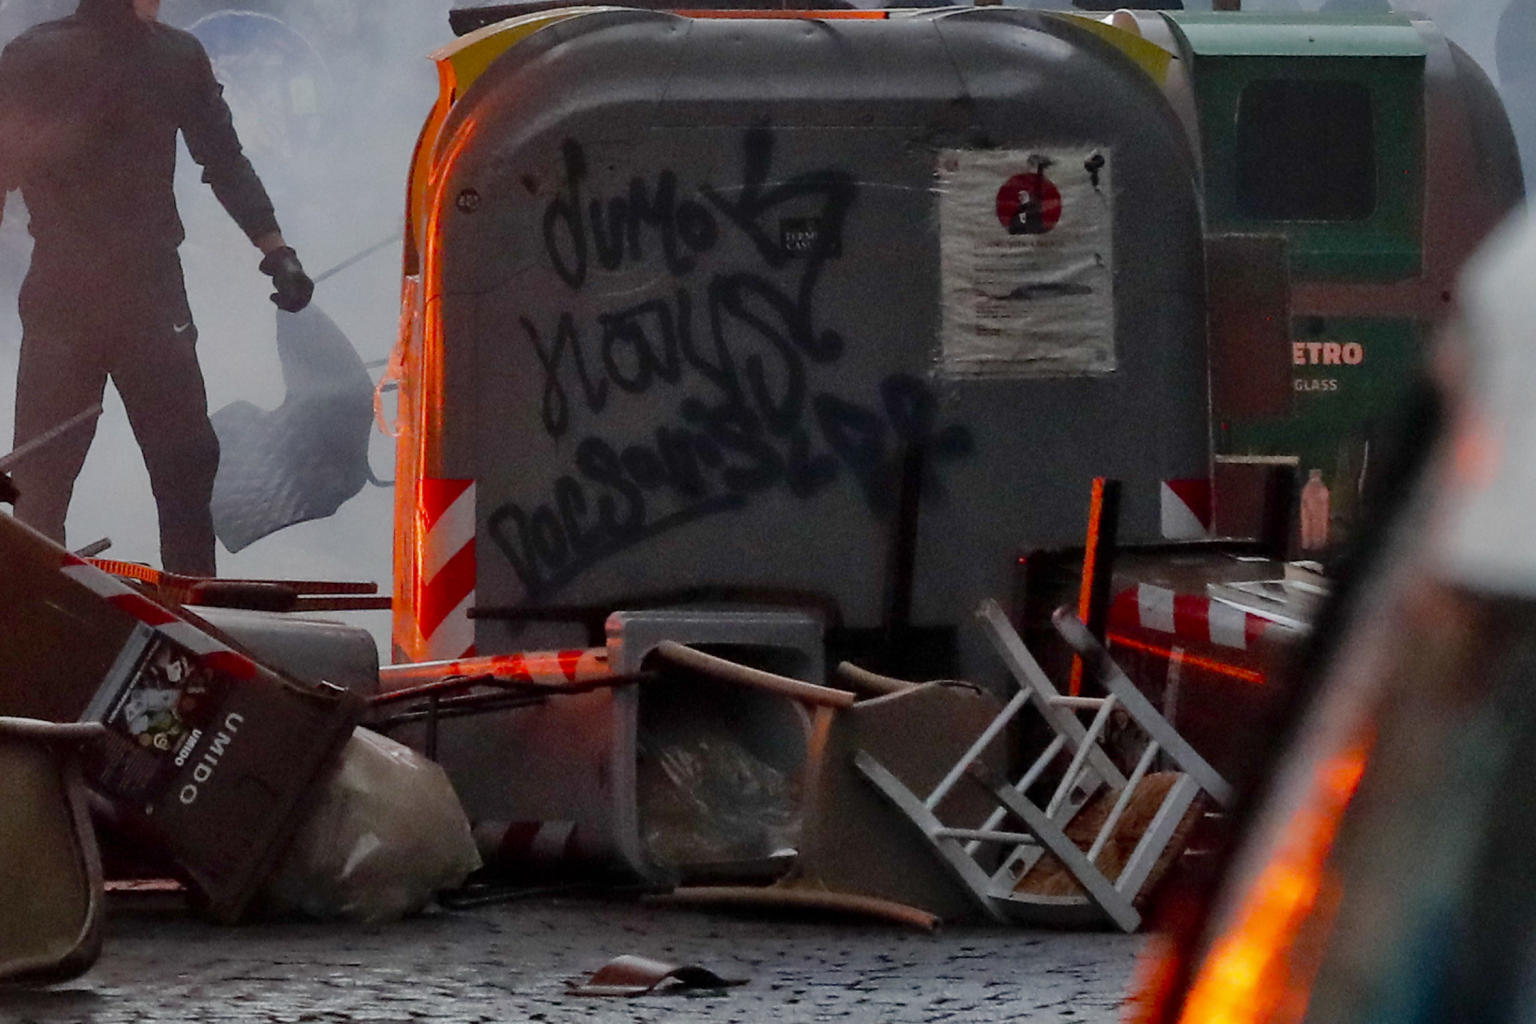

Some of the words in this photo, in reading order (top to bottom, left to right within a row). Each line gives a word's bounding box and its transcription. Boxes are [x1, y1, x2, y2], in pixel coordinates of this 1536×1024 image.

[1292, 342, 1364, 365] ETRO
[1294, 379, 1338, 392] GLASS
[174, 728, 203, 767] UMIDO
[180, 712, 245, 806] UMIDO
